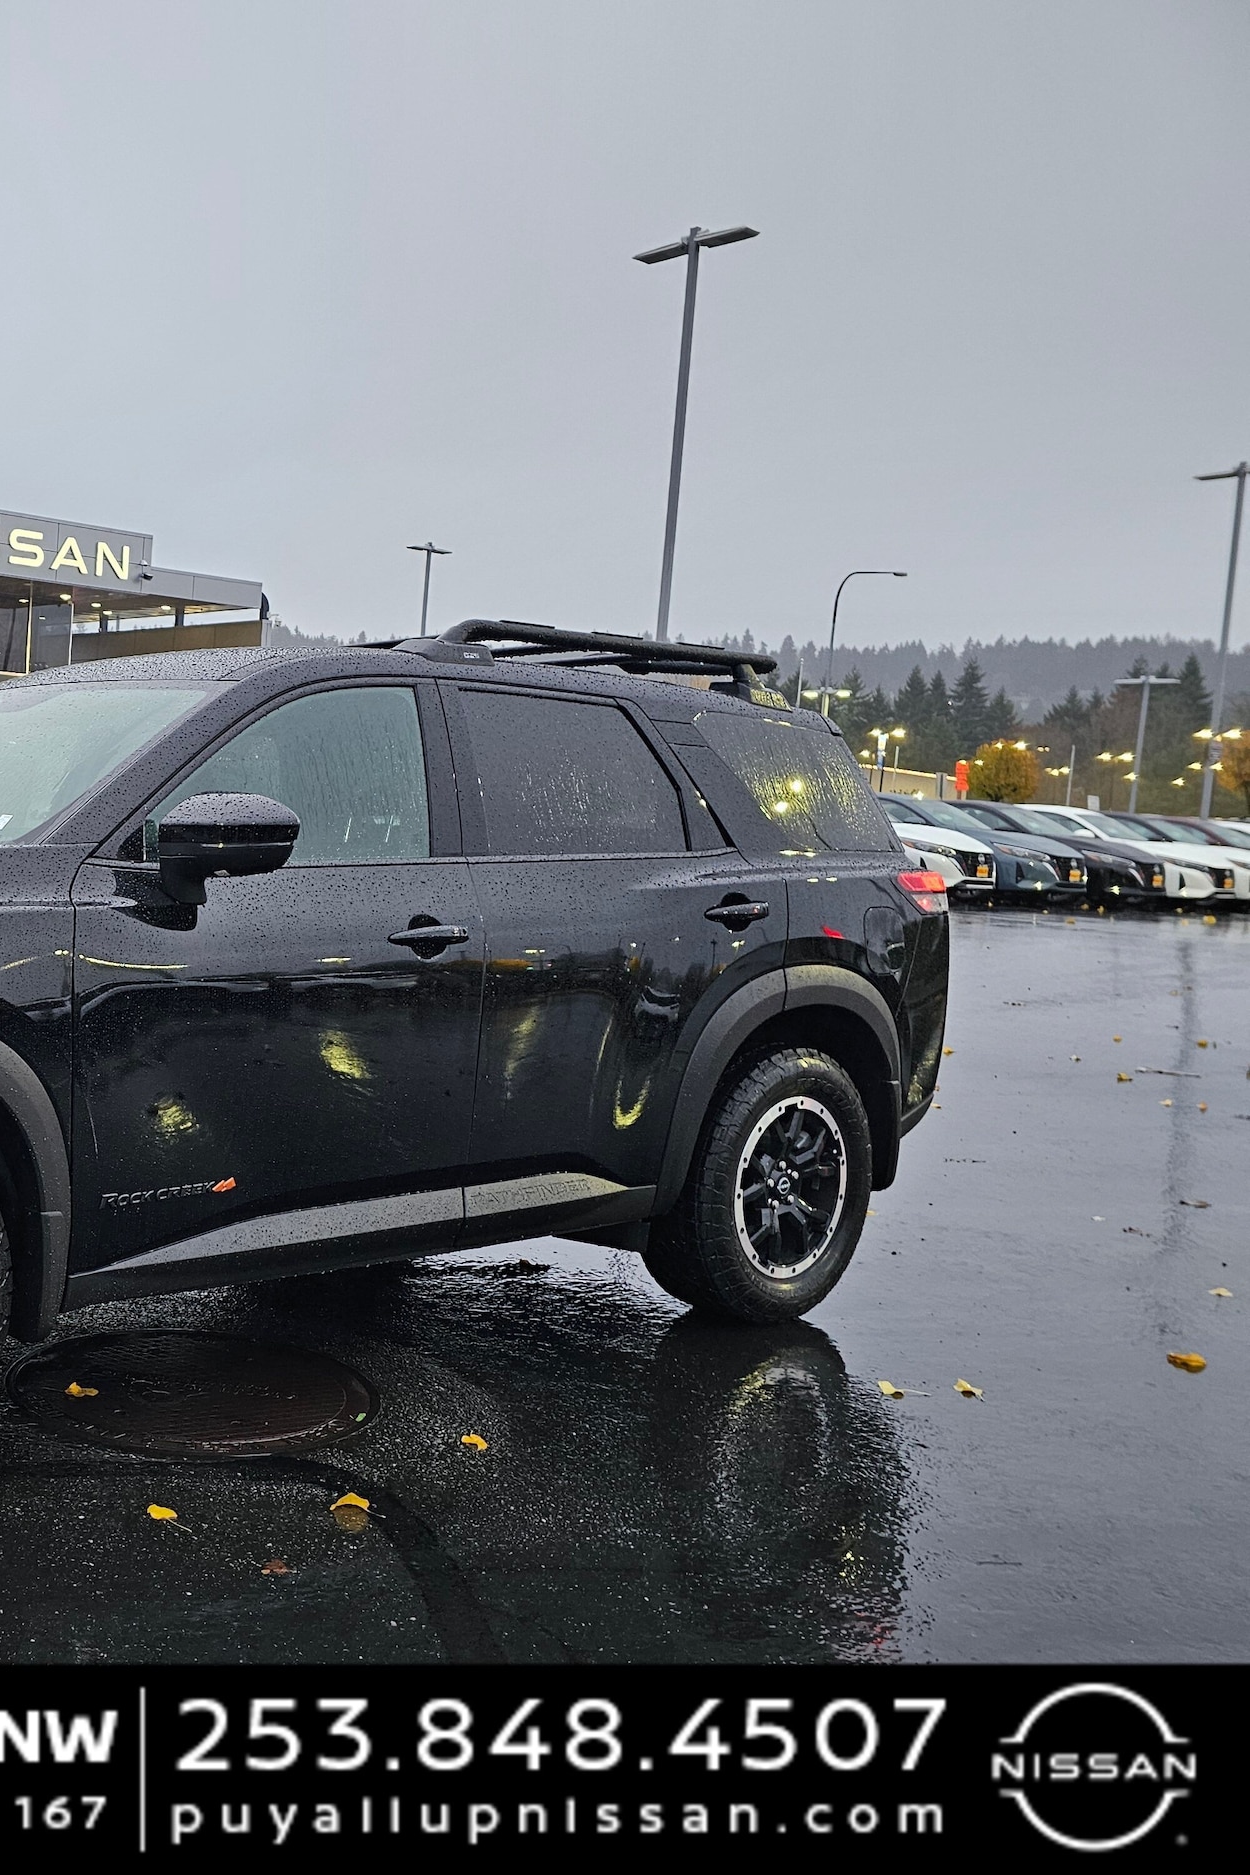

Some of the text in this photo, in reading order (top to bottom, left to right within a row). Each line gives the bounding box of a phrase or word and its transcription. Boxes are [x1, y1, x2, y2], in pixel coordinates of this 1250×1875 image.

[100, 1180, 216, 1210] ROCK CREEK
[469, 1177, 592, 1206] PATHFINDER
